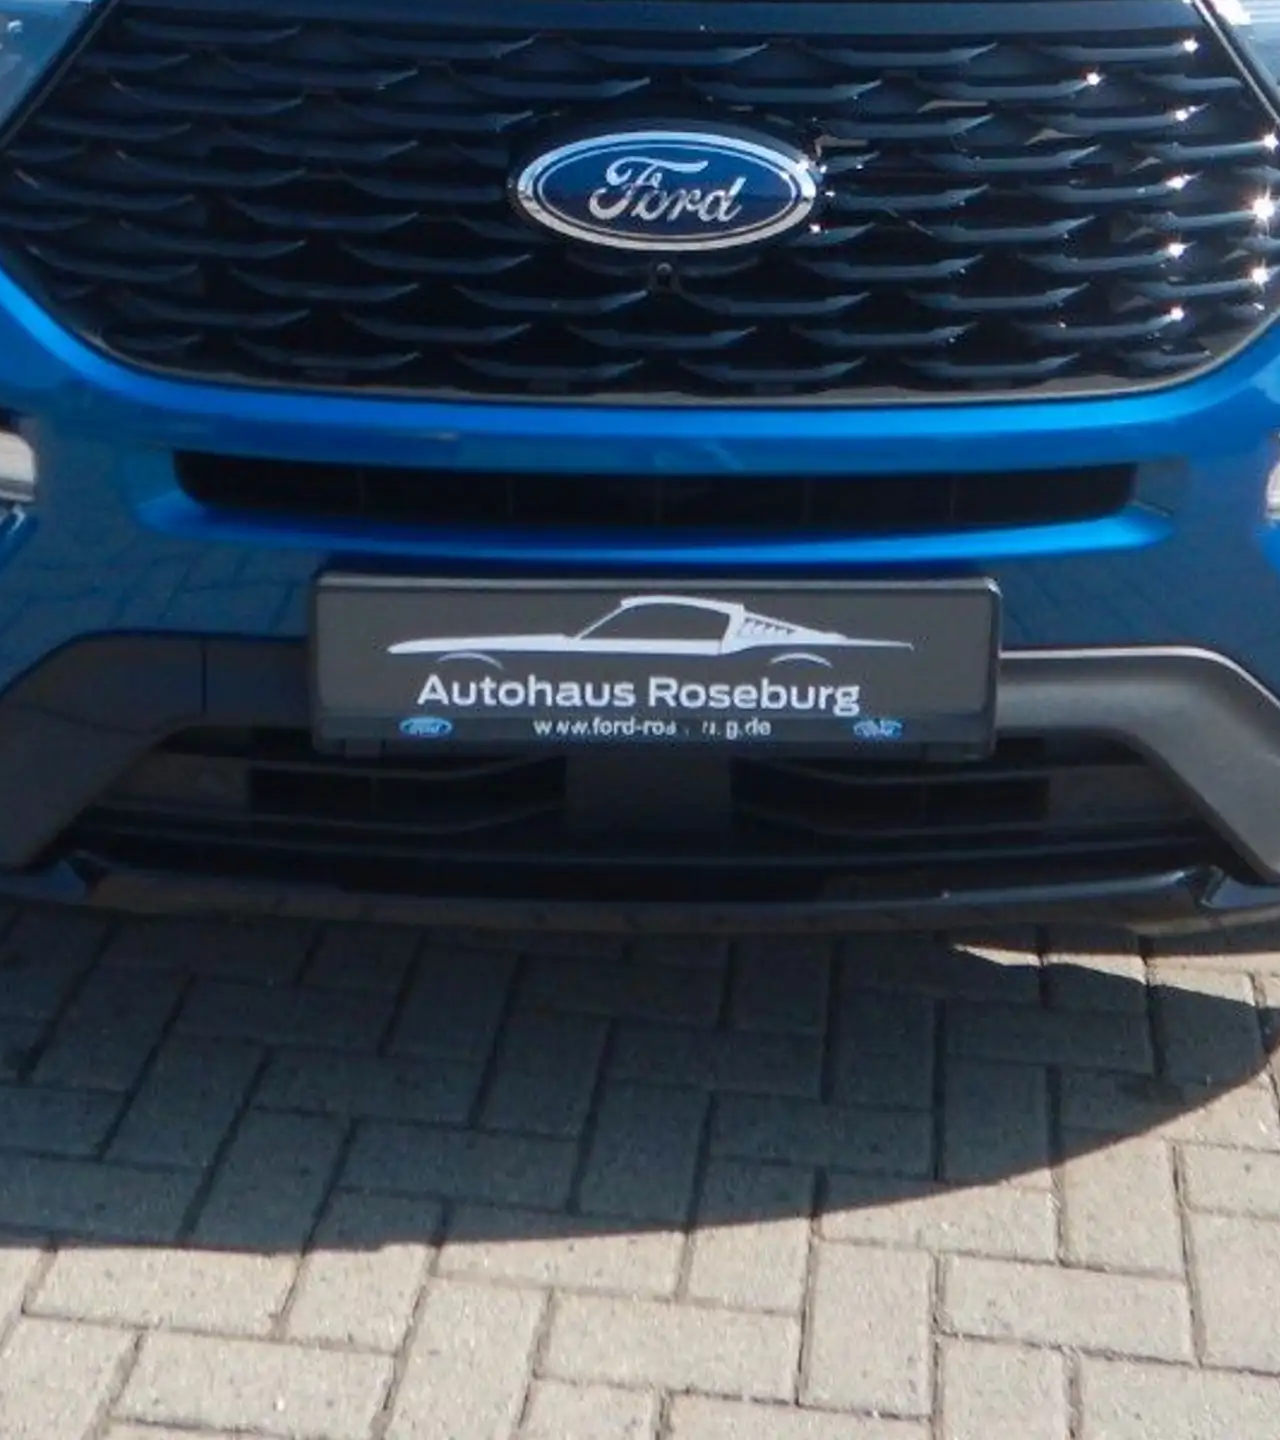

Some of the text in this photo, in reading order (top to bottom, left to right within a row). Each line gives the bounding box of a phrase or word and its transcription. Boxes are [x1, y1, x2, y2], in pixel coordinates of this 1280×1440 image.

[588, 156, 746, 222] Ford
[417, 674, 861, 717] Autohaus Roseburg
